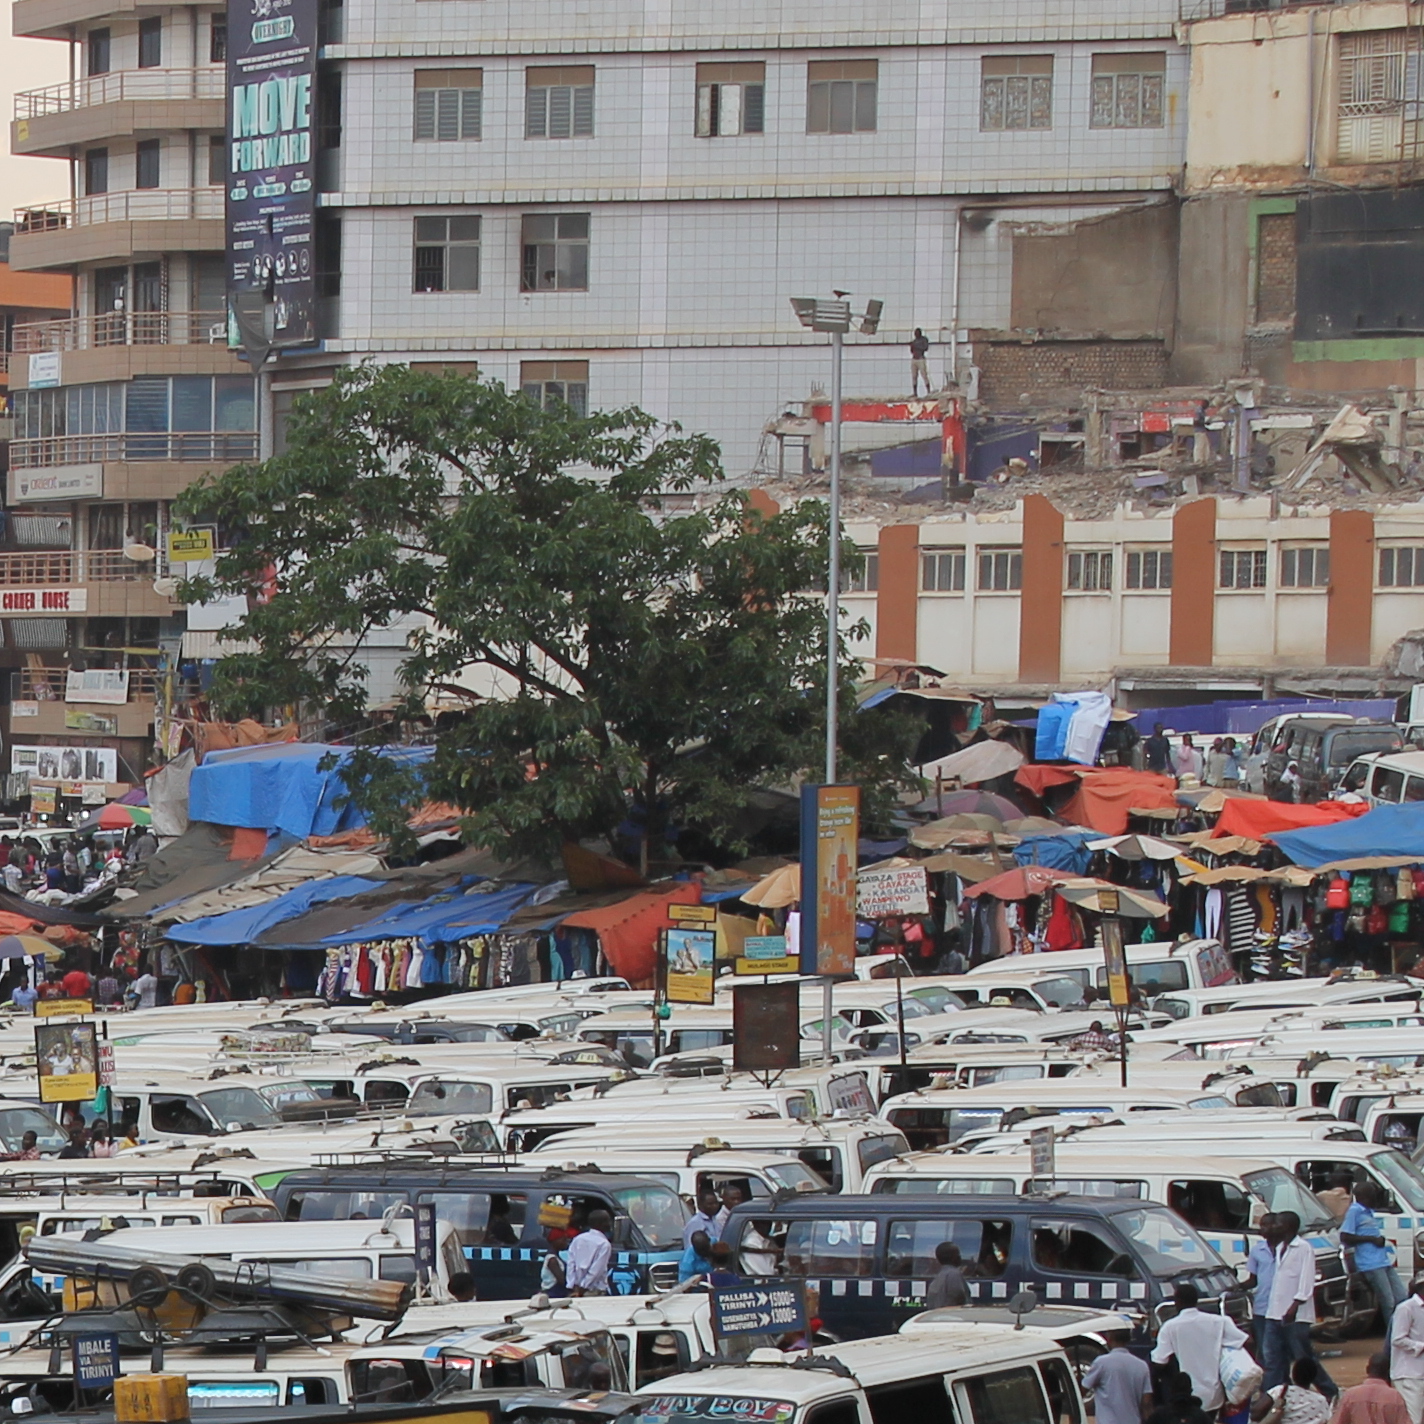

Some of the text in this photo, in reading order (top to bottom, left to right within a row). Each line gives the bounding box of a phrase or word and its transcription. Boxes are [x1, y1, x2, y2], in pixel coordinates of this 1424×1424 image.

[232, 73, 311, 139] MOVE
[231, 131, 310, 173] FORWARD
[897, 871, 923, 880] STAGE
[78, 1339, 112, 1355] MBALE
[79, 1356, 91, 1366] VIA
[80, 1364, 114, 1380] TIRINYI
[708, 1397, 777, 1416] BOY
